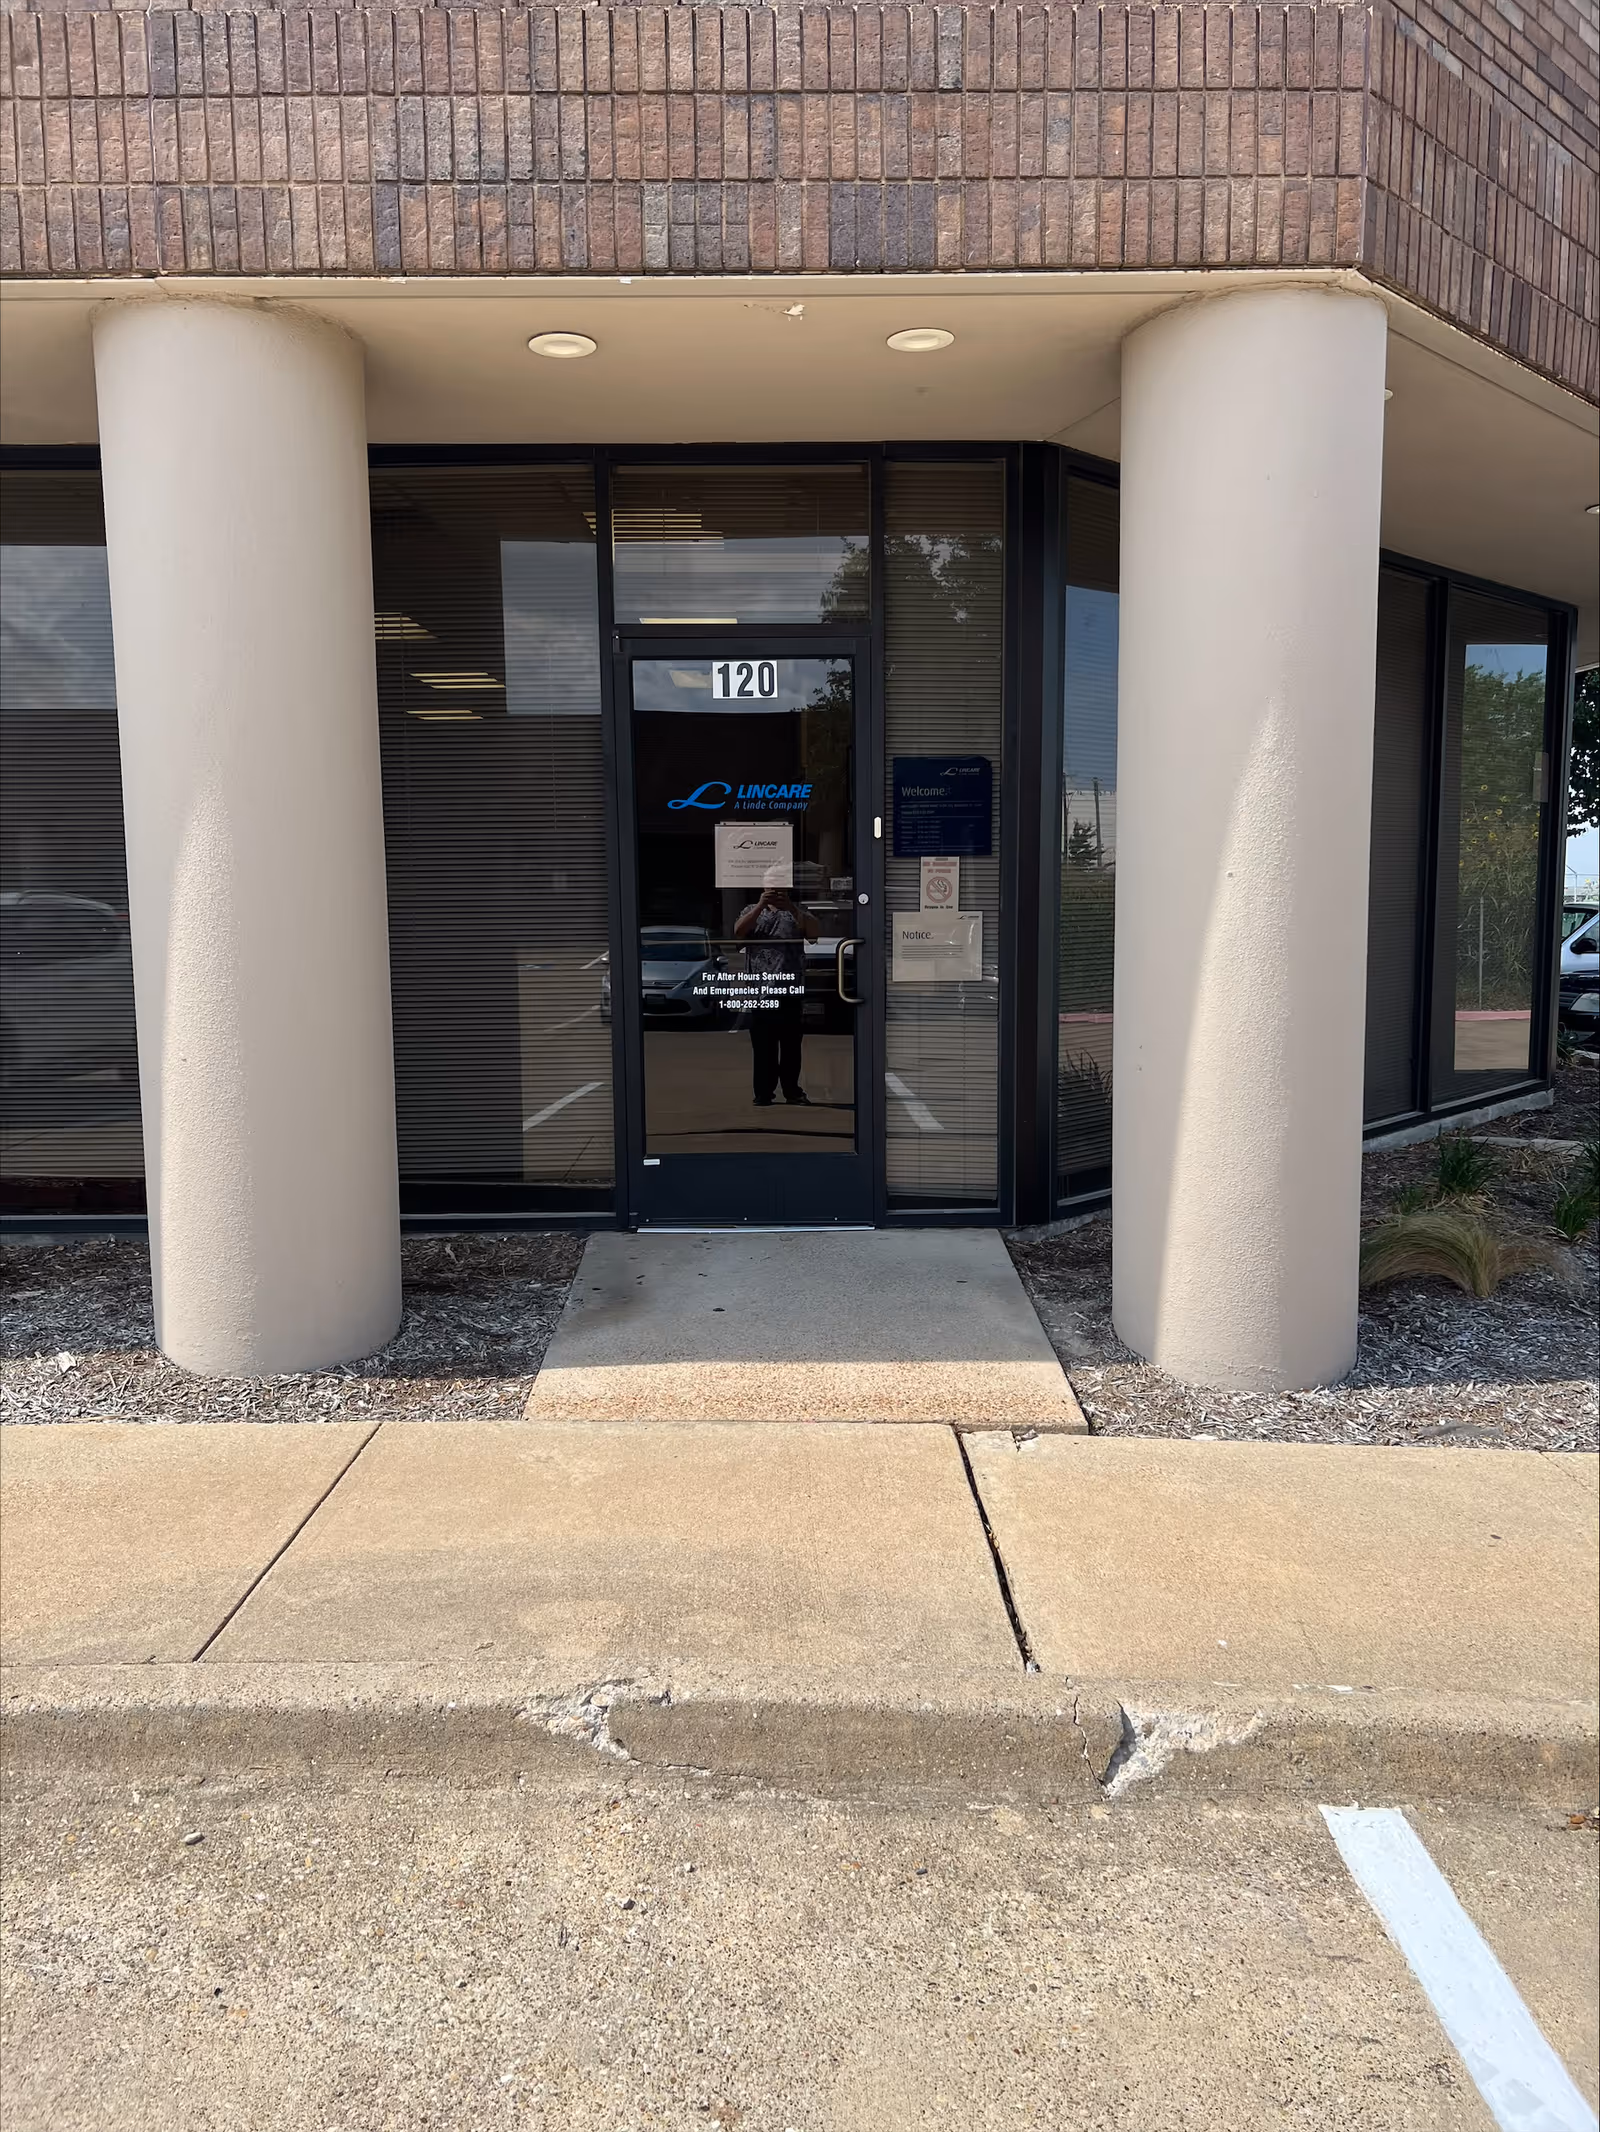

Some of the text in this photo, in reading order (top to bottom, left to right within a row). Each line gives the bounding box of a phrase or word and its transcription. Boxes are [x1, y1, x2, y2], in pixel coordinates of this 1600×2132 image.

[717, 662, 775, 698] 120
[737, 784, 813, 799] LINCARE
[901, 786, 948, 797] Welcome.
[734, 801, 808, 811] A Linde Company
[702, 971, 796, 981] For After Hours Services
[693, 985, 805, 996] And Emergencies Please Call
[719, 1000, 780, 1009] 1-800-262-2589
